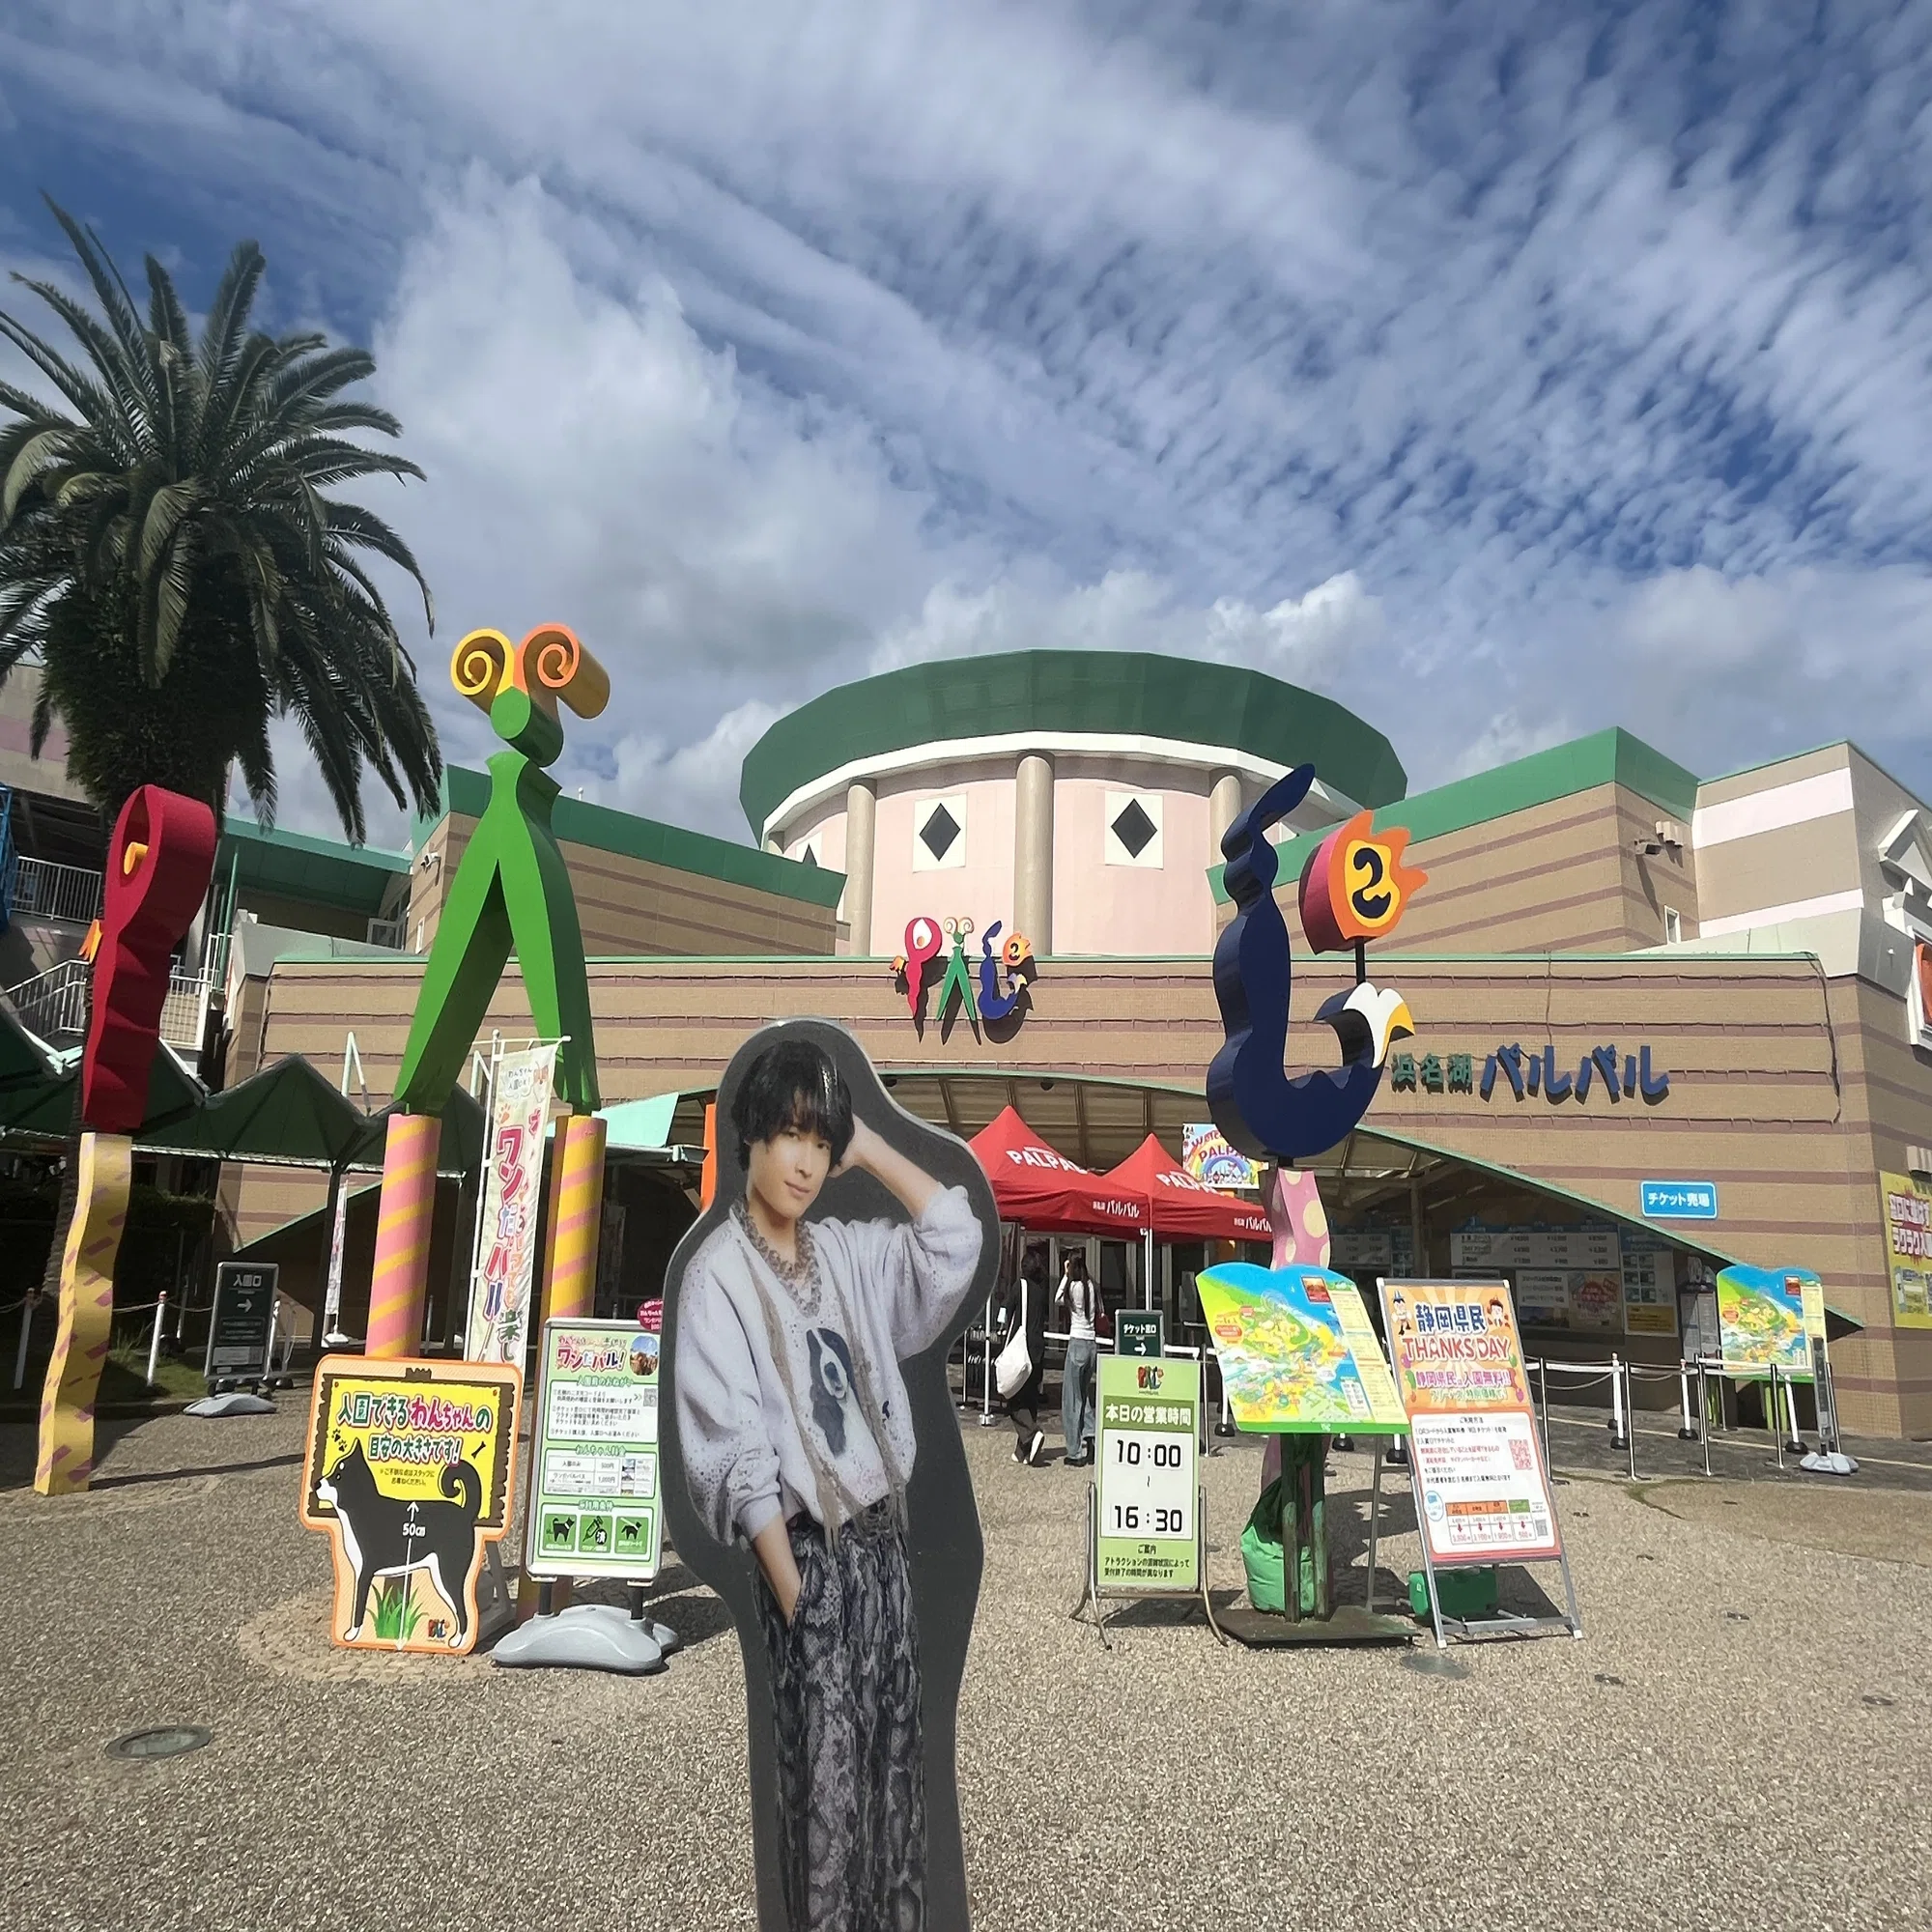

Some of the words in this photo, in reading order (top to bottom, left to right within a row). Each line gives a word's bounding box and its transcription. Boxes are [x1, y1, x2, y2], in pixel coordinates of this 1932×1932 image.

[1647, 1191, 1711, 1208] チケット売場
[1415, 1304, 1487, 1333] 静岡県民
[337, 1393, 491, 1430] 入園できるわんちゃんの
[1105, 1404, 1192, 1426] 本日の営業時間
